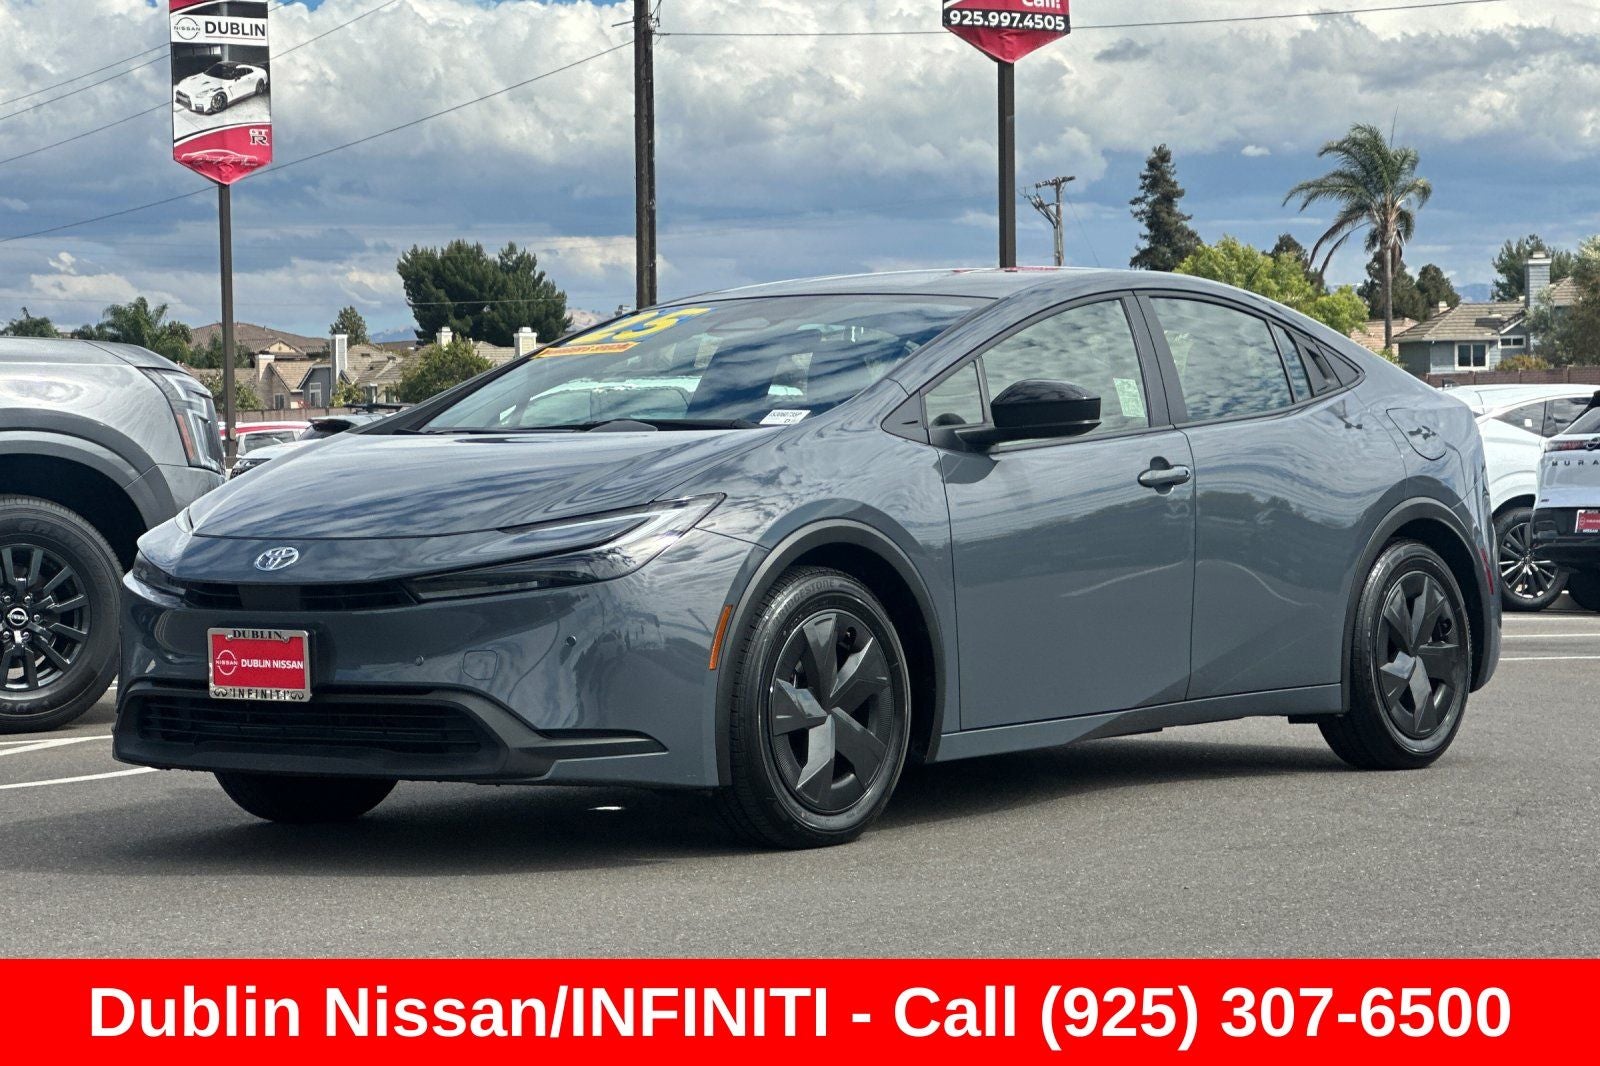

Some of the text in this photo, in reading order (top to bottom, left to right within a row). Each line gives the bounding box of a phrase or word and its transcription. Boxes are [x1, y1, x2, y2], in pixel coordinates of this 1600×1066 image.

[949, 10, 1065, 30] 925.997.4505
[205, 21, 265, 37] DUBLIN
[241, 659, 304, 669] DUBLIN NISSAN
